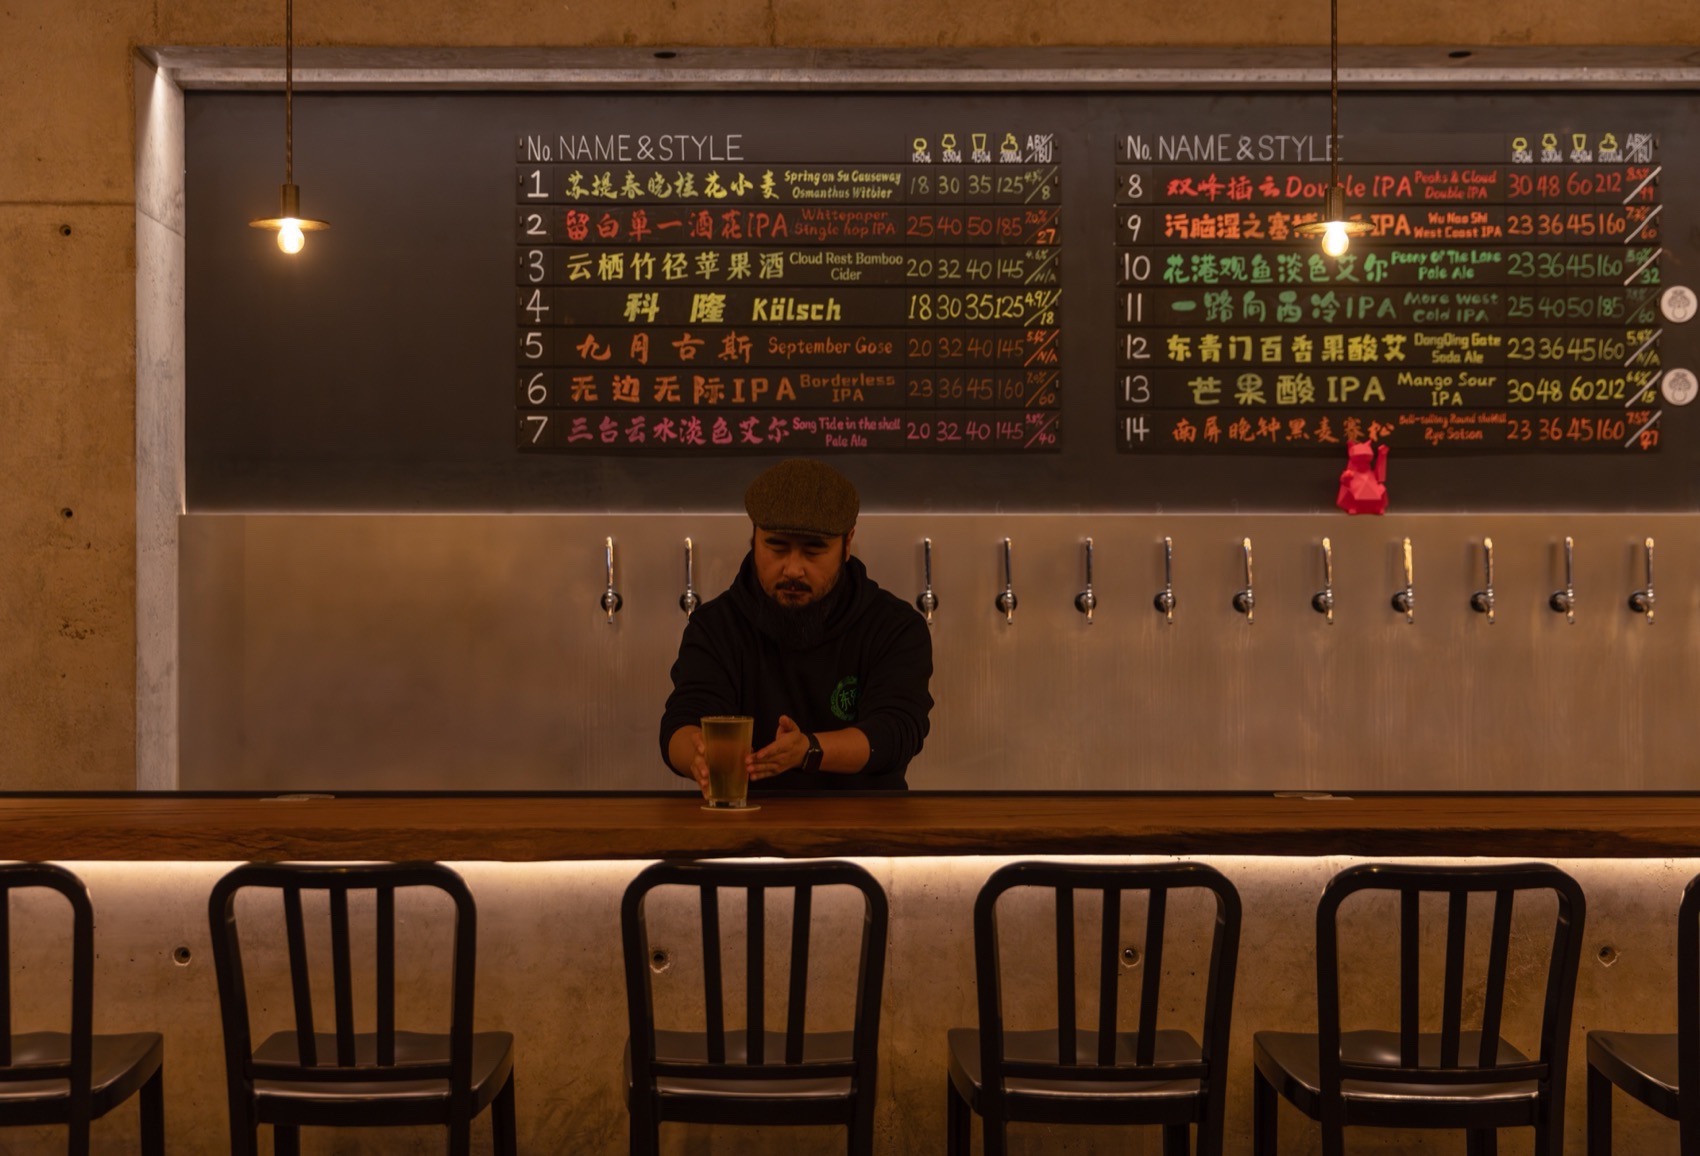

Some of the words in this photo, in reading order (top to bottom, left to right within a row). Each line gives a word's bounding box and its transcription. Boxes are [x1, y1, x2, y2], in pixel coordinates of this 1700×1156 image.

[528, 135, 552, 161] No.
[560, 135, 744, 161] NAME&STYLE
[1127, 135, 1152, 160] No.
[528, 170, 548, 197] 1
[785, 170, 820, 185] Spring
[822, 173, 834, 182] on
[837, 170, 849, 182] Su
[851, 170, 901, 185] Causeway
[911, 176, 929, 194] 18
[939, 176, 959, 194] 30
[969, 175, 991, 194] 35
[997, 176, 1025, 193] 125
[1040, 184, 1050, 200] 8
[1128, 174, 1142, 198] 8
[1373, 176, 1412, 197] IPA
[1462, 170, 1496, 183] Cloud
[1509, 173, 1533, 197] 30
[1537, 176, 1560, 197] 48
[1567, 172, 1592, 195] 60
[1596, 173, 1621, 193] 212
[792, 185, 849, 198] Osmanthus
[853, 187, 892, 198] Witbier
[1425, 186, 1463, 199] Double
[527, 214, 546, 235] 2
[907, 216, 933, 237] 25
[937, 216, 962, 235] 40
[967, 216, 992, 236] 50
[997, 217, 1022, 236] 185
[1037, 229, 1055, 244] 27
[1128, 215, 1141, 241] 9
[1428, 213, 1445, 224] Wu
[1508, 215, 1533, 234] 23
[1538, 214, 1563, 235] 36
[1567, 214, 1595, 235] 45
[1599, 213, 1625, 235] 160
[795, 222, 838, 241] Single
[844, 222, 869, 238] hop
[873, 222, 895, 234] IPA
[1414, 227, 1441, 238] West
[1445, 226, 1478, 238] Coast
[1482, 226, 1502, 237] IPA
[529, 250, 544, 282] 3
[567, 251, 783, 281] 云栖竹径苹果酒
[789, 252, 822, 264] Cloud
[826, 252, 852, 264] Rest
[856, 252, 903, 265] Bamboo
[907, 259, 932, 277] 20
[938, 259, 961, 279] 32
[966, 259, 992, 280] 40
[997, 259, 1023, 279] 145
[1125, 253, 1150, 280] 10
[1508, 252, 1535, 277] 23
[1538, 253, 1564, 278] 36
[1566, 254, 1595, 278] 45
[1598, 254, 1622, 277] 160
[1640, 266, 1659, 283] 32
[831, 268, 862, 280] Cider
[1419, 266, 1447, 280] Pale
[1452, 266, 1473, 279] Ale
[526, 289, 549, 322] 4
[624, 293, 726, 322] 科隆
[752, 298, 841, 321] Kölsch
[909, 294, 932, 320] 18
[937, 294, 961, 320] 30
[965, 293, 995, 320] 35
[993, 296, 1024, 318] 125
[1039, 310, 1054, 325] 18
[1128, 293, 1142, 321] 11
[1172, 290, 1396, 322] 一路向西冷IPA
[1404, 292, 1449, 305] More
[1508, 296, 1533, 317] 25
[1539, 297, 1565, 318] 40
[1567, 297, 1593, 317] 50
[1598, 296, 1623, 317] 185
[1637, 308, 1654, 323] 60
[1413, 308, 1450, 322] Cold
[1457, 309, 1488, 322] IPA
[526, 332, 543, 358] 5
[576, 331, 752, 364] 九月古斯
[768, 336, 851, 359] September
[855, 337, 892, 354] Gose
[909, 338, 931, 357] 20
[939, 337, 962, 357] 32
[967, 338, 992, 357] 40
[997, 339, 1024, 358] 145
[1127, 334, 1150, 359] 12
[1167, 334, 1406, 362] 东青门百香果酸艾
[1472, 333, 1501, 346] Gate
[1507, 337, 1535, 360] 23
[1539, 337, 1564, 360] 36
[1567, 338, 1596, 361] 45
[1598, 338, 1624, 360] 160
[1465, 351, 1483, 363] Ale
[528, 373, 546, 404] 6
[571, 375, 795, 404] 无边无际IPA
[800, 373, 895, 388] Borderless
[909, 379, 932, 397] 23
[939, 378, 963, 398] 36
[967, 378, 992, 399] 45
[998, 378, 1023, 399] 160
[1037, 391, 1055, 405] 60
[1126, 375, 1150, 402] 13
[1398, 372, 1452, 390] Mango
[1458, 372, 1496, 387] Sour
[1507, 379, 1535, 402] 30
[1536, 378, 1562, 403] 48
[1570, 376, 1594, 401] 60
[1593, 379, 1625, 400] 212
[1640, 388, 1654, 402] 15
[832, 386, 864, 402] IPA
[1432, 390, 1462, 406] IPA
[527, 416, 548, 443] 7
[793, 417, 817, 433] Song
[818, 417, 844, 430] Tide
[907, 422, 930, 439] 20
[936, 421, 961, 441] 32
[966, 421, 991, 440] 40
[997, 421, 1023, 439] 145
[1037, 429, 1055, 444] 40
[1127, 417, 1149, 441] 14
[1505, 419, 1532, 440] 23
[1540, 418, 1562, 440] 36
[1567, 417, 1593, 440] 45
[1597, 419, 1624, 440] 160
[826, 434, 848, 447] Pale
[850, 434, 867, 447] Ale
